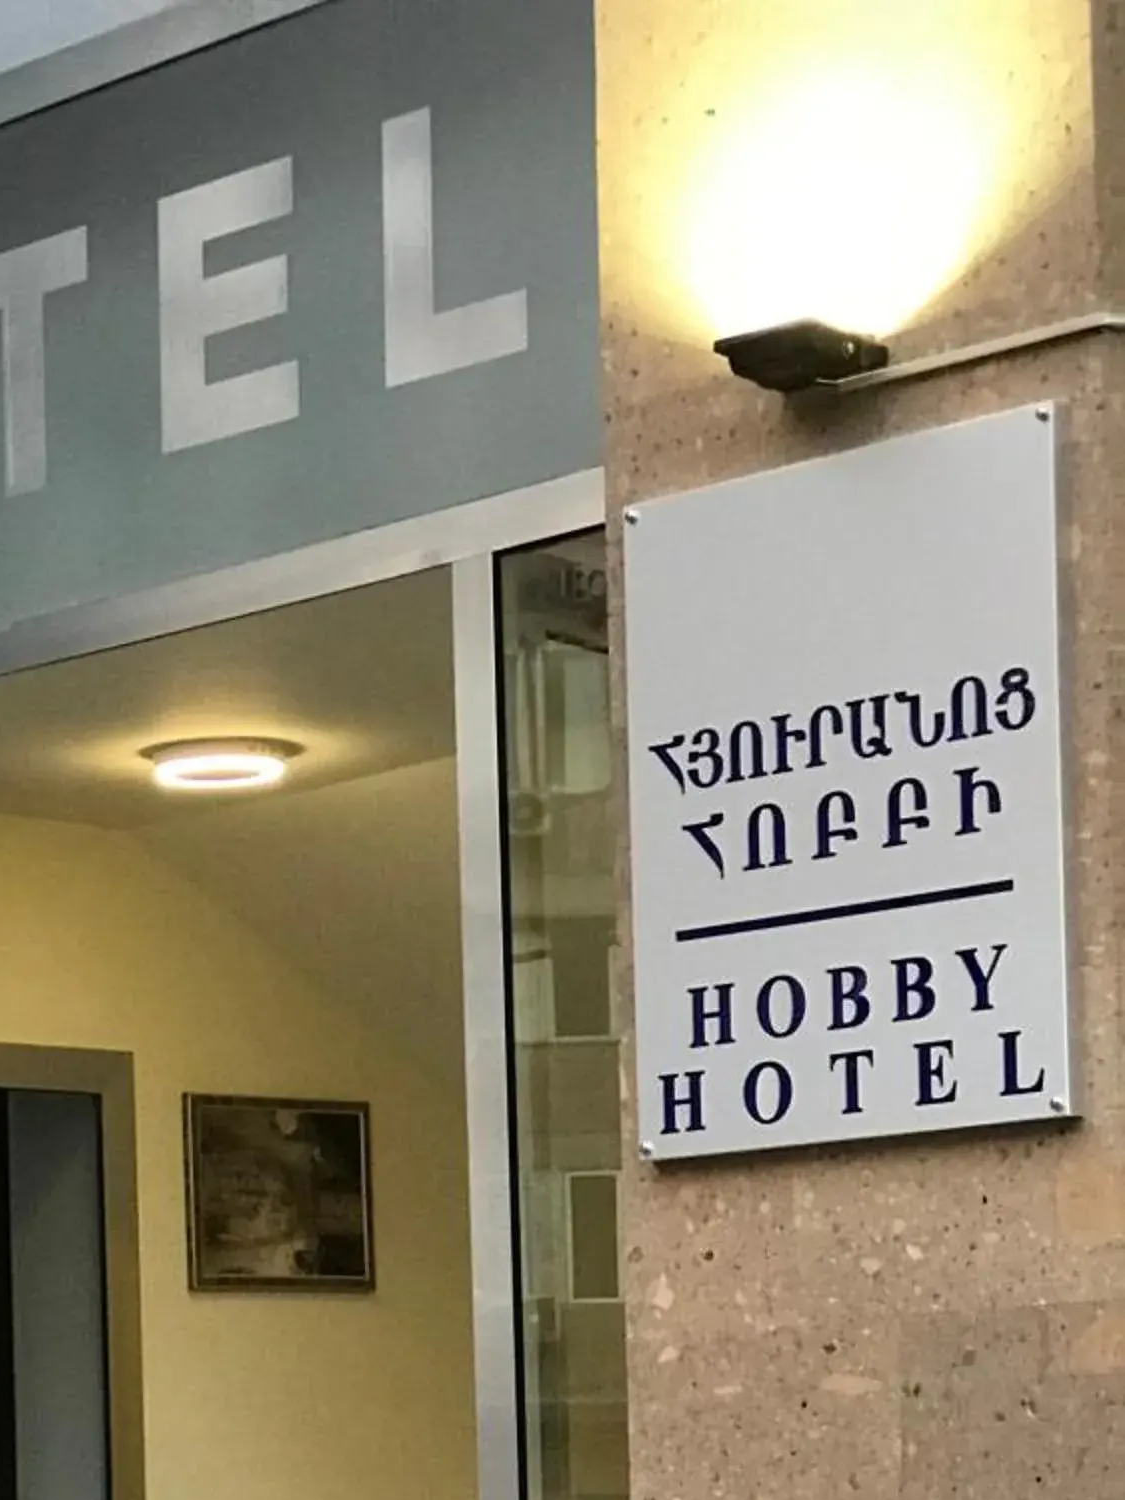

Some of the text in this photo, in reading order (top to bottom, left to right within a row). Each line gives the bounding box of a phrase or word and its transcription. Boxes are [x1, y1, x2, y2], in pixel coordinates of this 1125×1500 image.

[648, 667, 1036, 795] ՀՅՈՒՐԱՆՈՑ
[681, 766, 1002, 879] ՀՈԲԲԻ
[687, 944, 1008, 1049] HOBBY
[658, 1031, 1045, 1135] HOTEL
